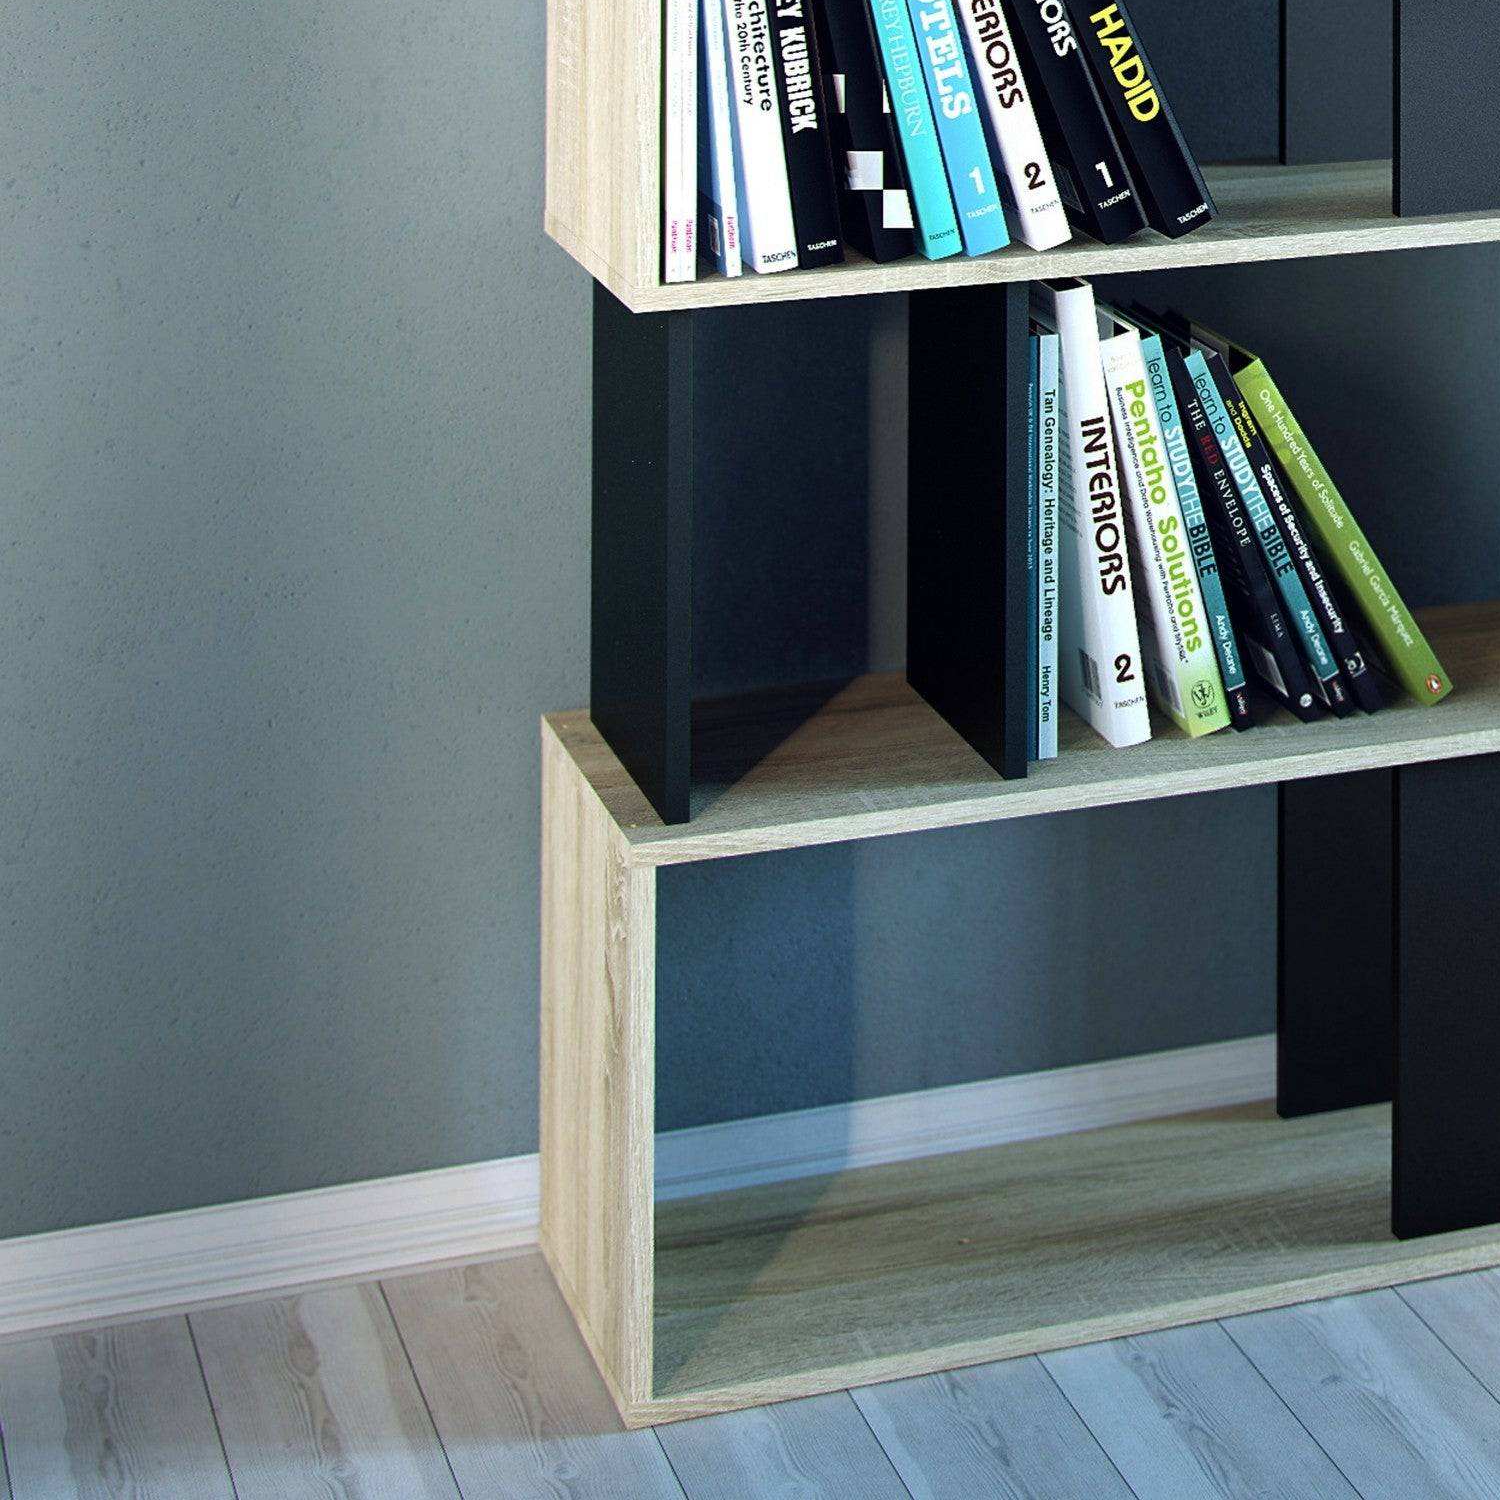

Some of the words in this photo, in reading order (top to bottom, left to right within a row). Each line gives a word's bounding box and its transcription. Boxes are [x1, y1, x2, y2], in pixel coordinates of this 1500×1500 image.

[740, 55, 753, 106] Century
[779, 25, 818, 134] KUBRICK
[1089, 3, 1161, 122] HADID
[888, 30, 927, 137] HEPBURN
[968, 165, 986, 195] 1
[1023, 161, 1046, 190] 2
[1094, 161, 1114, 188] 1
[966, 204, 998, 220] TASCHEN
[1030, 199, 1060, 213] TASCHEN
[1098, 189, 1131, 210] TASCHEN
[1176, 202, 1209, 225] TASCHEN
[807, 239, 837, 251] TASCHEN
[928, 228, 955, 241] TASCHEN
[762, 250, 797, 264] TASCHEN
[1044, 389, 1056, 414] Tan
[1148, 357, 1167, 401] learn
[1160, 403, 1173, 423] to
[1193, 372, 1218, 416] learn
[1211, 415, 1226, 435] to
[1225, 398, 1238, 416] and
[1234, 416, 1252, 449] Dodds
[1041, 416, 1056, 494] Genealogy:
[1187, 399, 1206, 431] THE
[1200, 434, 1219, 465] RED
[1213, 468, 1252, 548] ENVELOPE
[1259, 389, 1276, 413] One
[1273, 412, 1301, 455] Hundred
[1297, 450, 1315, 479] Years
[1311, 478, 1324, 492] of
[1318, 489, 1344, 529] Solitude
[1260, 463, 1285, 503] Spaces
[1080, 416, 1126, 596] INTERIORS
[1115, 386, 1128, 420] Business
[1124, 421, 1140, 469] Intelligence
[1135, 470, 1145, 488] and
[1140, 488, 1149, 509] Data
[1145, 509, 1162, 563] Warehousing
[1170, 615, 1180, 632] and
[1125, 379, 1166, 504] Pentaho
[1158, 515, 1202, 652] Solutions
[1278, 502, 1291, 516] of
[1041, 498, 1056, 555] Heritage
[1284, 514, 1310, 560] Security
[1044, 558, 1056, 584] and
[1304, 560, 1319, 582] and
[1348, 540, 1374, 577] Gabriel
[1041, 588, 1055, 642] Lineage
[1300, 608, 1316, 635] Andy
[1314, 577, 1344, 634] Insecurity
[1215, 614, 1228, 641] Andy
[1222, 640, 1236, 675] Deane
[1040, 665, 1051, 697] Henry
[1114, 653, 1135, 683] 2
[1042, 699, 1052, 723] Tom
[1114, 695, 1144, 709] TASCHEN
